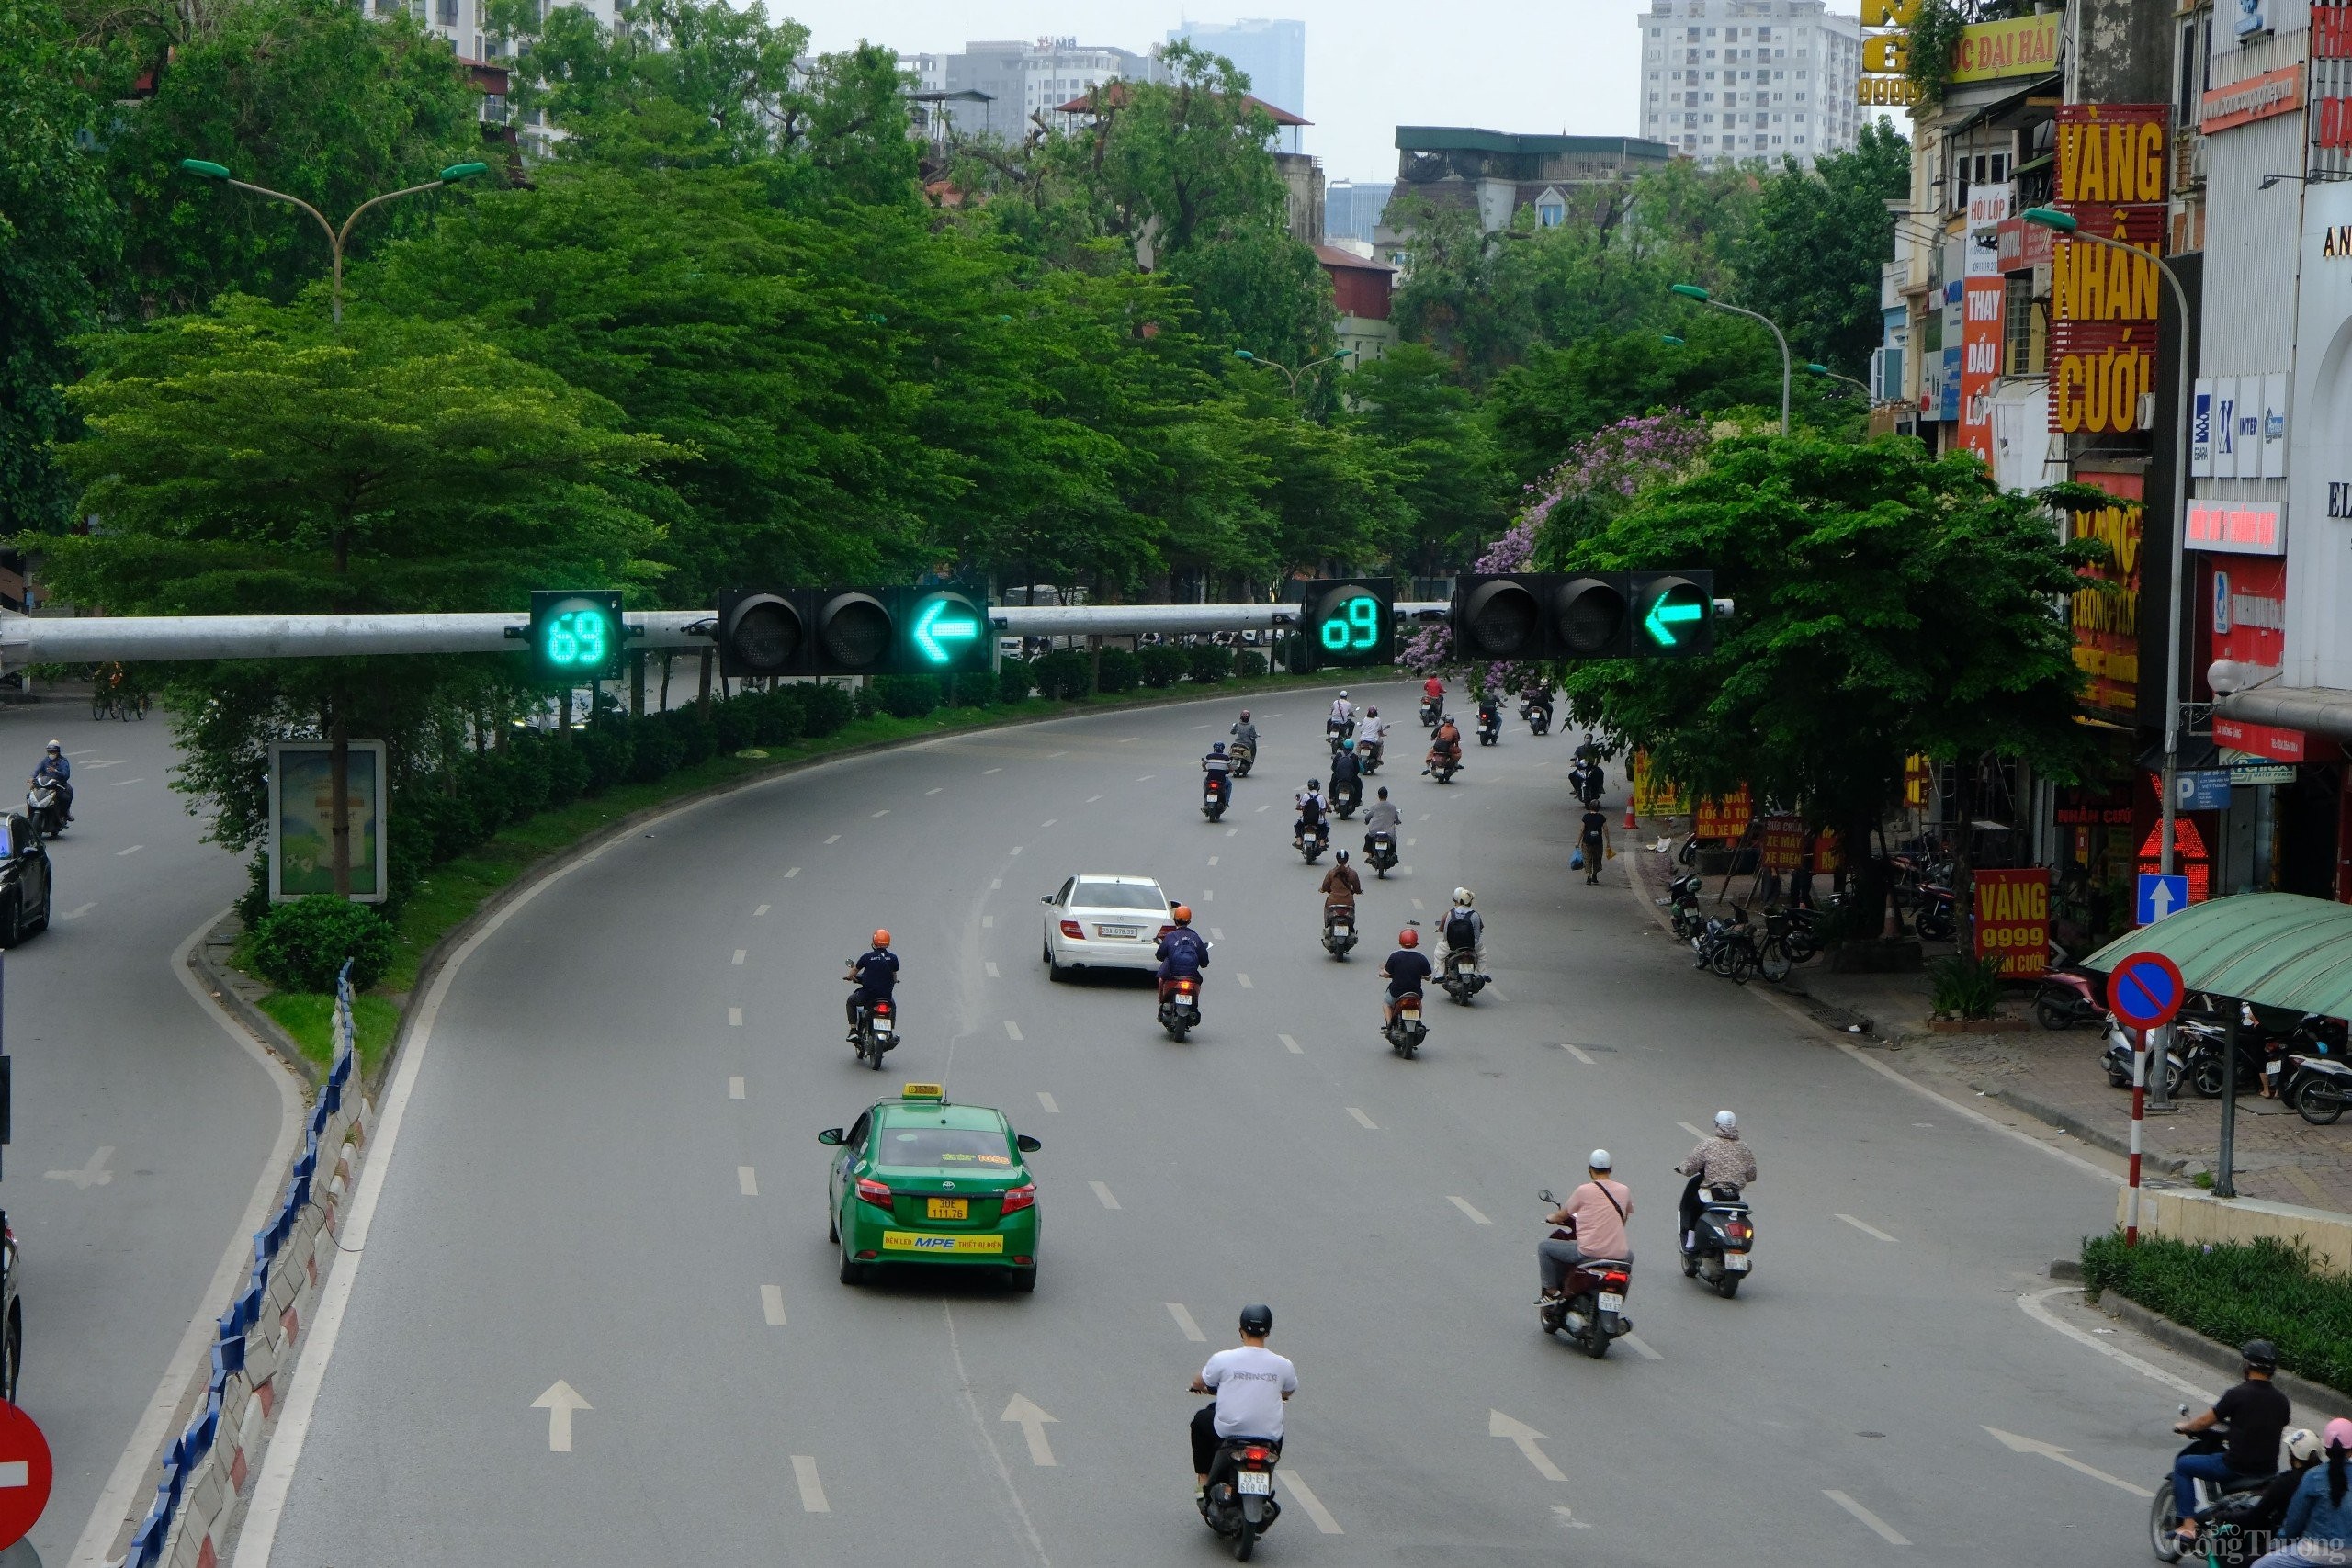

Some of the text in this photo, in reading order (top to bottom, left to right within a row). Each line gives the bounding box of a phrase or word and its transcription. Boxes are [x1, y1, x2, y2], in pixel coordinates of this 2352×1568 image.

[1978, 32, 2014, 77] ĐẠI
[2018, 17, 2055, 64] HẢI
[2059, 105, 2162, 201] VÀNG
[1987, 191, 2005, 220] LỐP
[2052, 209, 2159, 320] NHẪN
[1968, 290, 2001, 321] THAY
[1968, 333, 1996, 373] DẦU
[2239, 417, 2258, 436] INTER
[550, 610, 603, 664] 69
[2177, 778, 2194, 808] P
[1718, 825, 1729, 836] XE
[1766, 835, 1778, 846] XE
[1764, 852, 1778, 863] XE
[1980, 875, 2046, 921] VÀNG
[1982, 927, 2044, 947] 9999
[932, 1208, 964, 1218] 111.76
[938, 1199, 956, 1209] 30E
[915, 1237, 956, 1248] MPE
